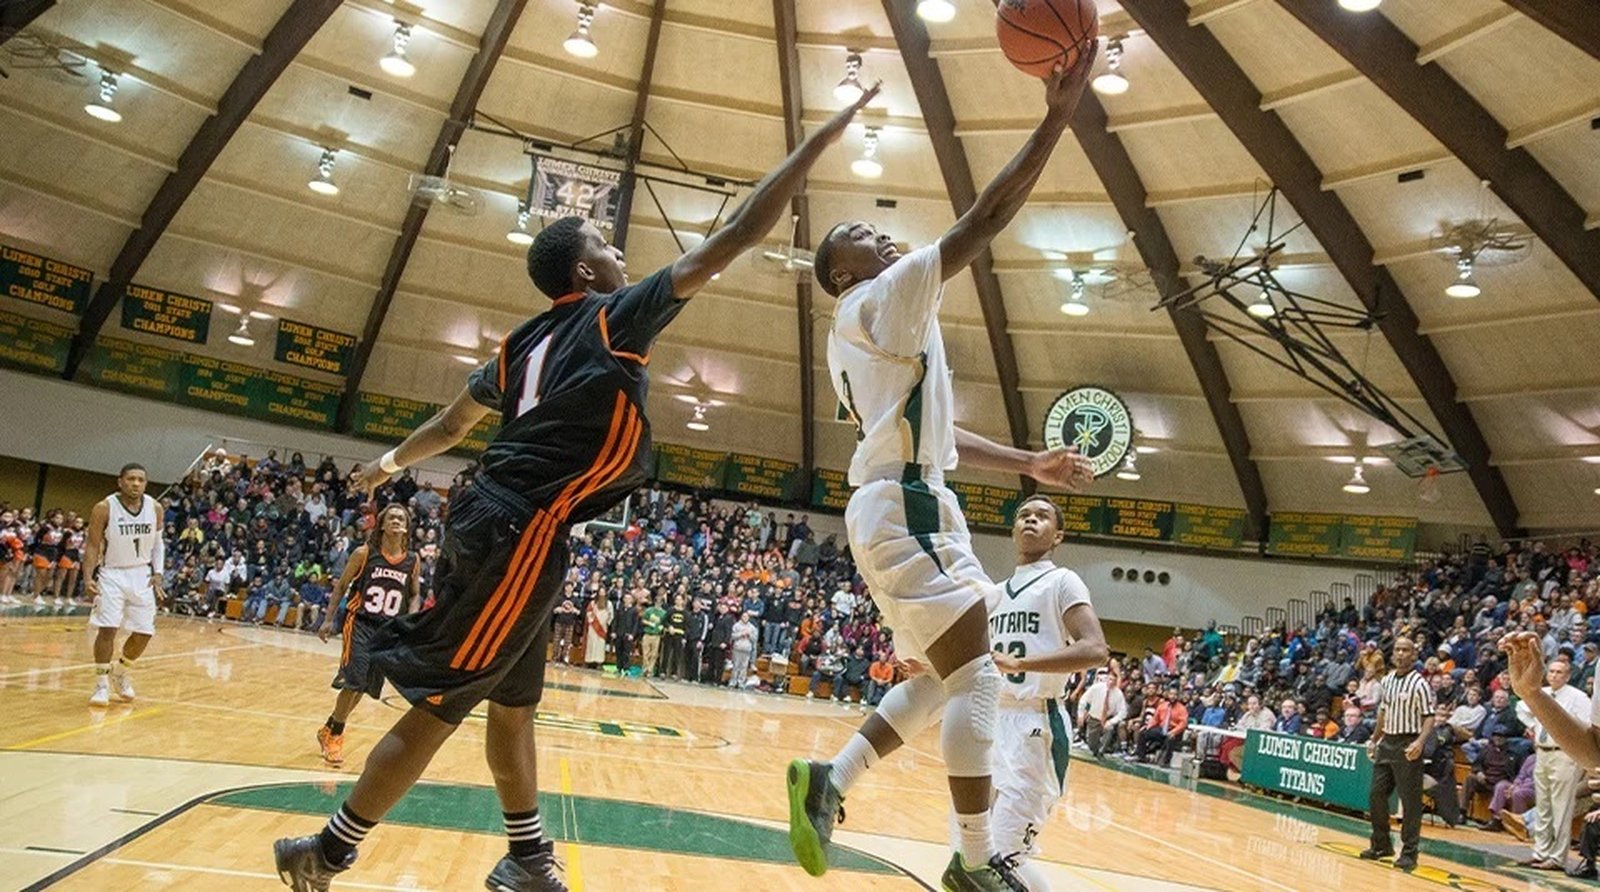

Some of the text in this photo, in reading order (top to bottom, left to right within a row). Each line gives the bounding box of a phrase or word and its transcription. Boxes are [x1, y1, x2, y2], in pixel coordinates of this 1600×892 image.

[556, 181, 595, 211] 42
[3, 248, 91, 283] LUMEN CHRISTI
[9, 284, 75, 311] CHAMPIONS
[126, 285, 211, 314] LUMEN CHRISTI
[134, 318, 196, 340] CHAMPIONS
[280, 321, 354, 347] LUMEN CHRISTI
[286, 351, 341, 372] CHAMPIONS
[516, 333, 554, 417] 1
[1048, 390, 1091, 429] LUMEN
[1093, 391, 1128, 435] CHRISTI
[1107, 499, 1171, 513] LUMEN CHRISTI
[118, 522, 153, 536] TITANS
[1113, 524, 1161, 538] CHAMPIONS
[132, 537, 140, 558] 1
[364, 585, 403, 617] 30
[989, 610, 1041, 639] TITANS
[1258, 734, 1359, 771] LUMEN CHRISTI
[1279, 766, 1326, 796] TITANS
